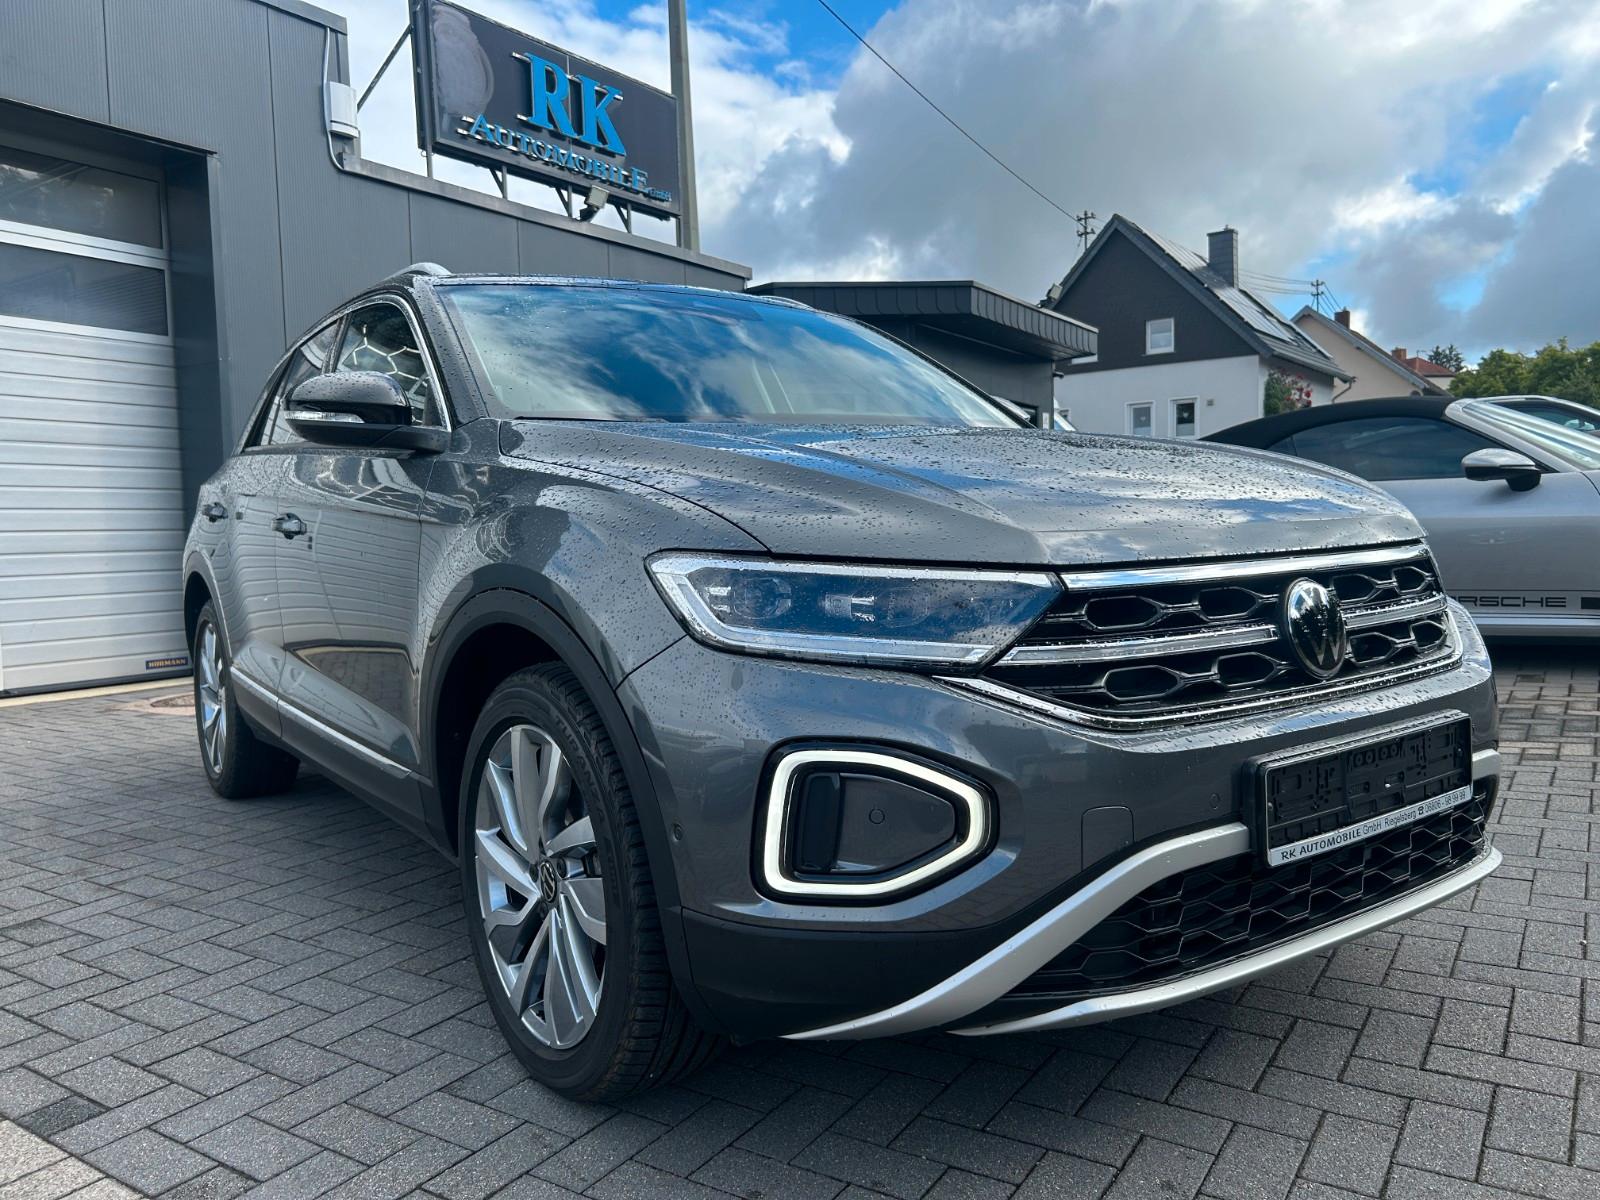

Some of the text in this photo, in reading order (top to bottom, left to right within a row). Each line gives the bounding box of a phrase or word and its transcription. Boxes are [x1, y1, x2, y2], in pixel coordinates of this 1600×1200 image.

[515, 52, 626, 157] RK
[461, 114, 649, 195] AUTOMOBILE
[1448, 596, 1567, 608] RSCHE
[1281, 848, 1296, 861] RK
[1299, 828, 1361, 856] AUTOMOBILE
[1363, 819, 1382, 835] GmbH
